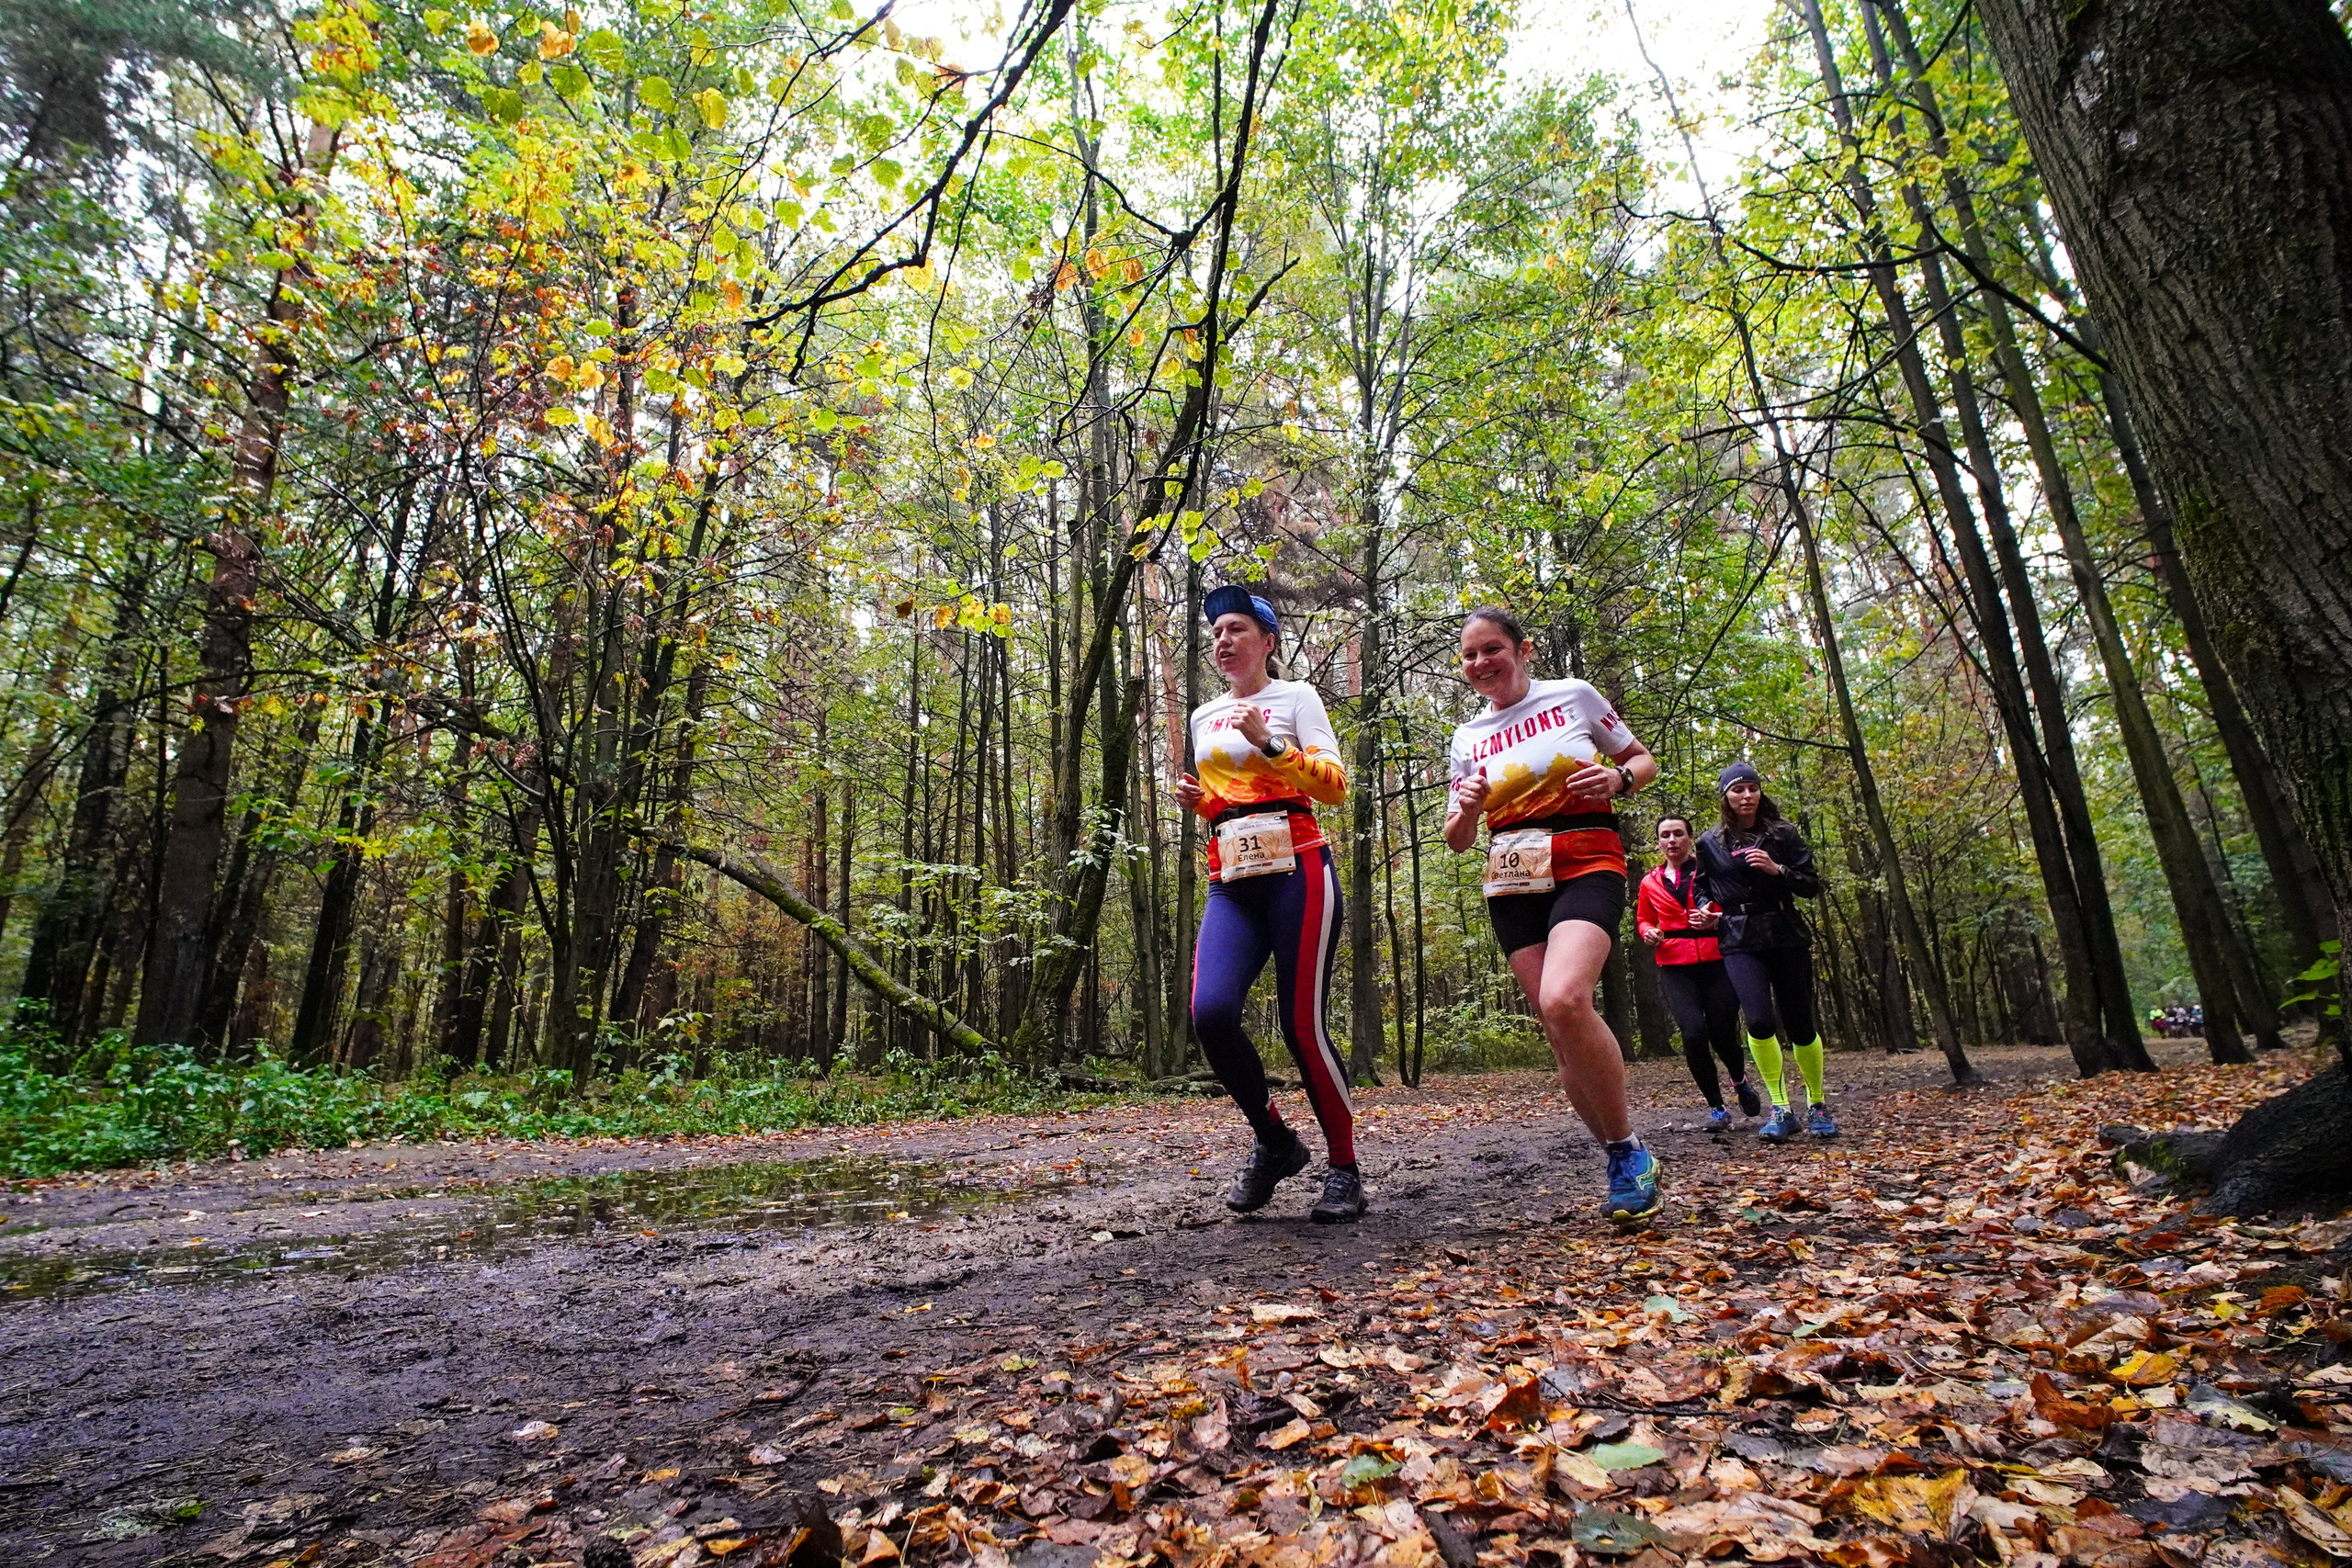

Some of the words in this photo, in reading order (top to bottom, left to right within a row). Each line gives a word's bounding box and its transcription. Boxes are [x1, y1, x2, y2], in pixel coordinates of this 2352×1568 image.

[1202, 708, 1272, 737] IZMYG
[1473, 705, 1566, 763] IZMYLONG
[1238, 835, 1262, 852] 31
[1238, 852, 1265, 862] Елена
[1499, 852, 1520, 869] 10
[1491, 870, 1531, 880] Светлана
